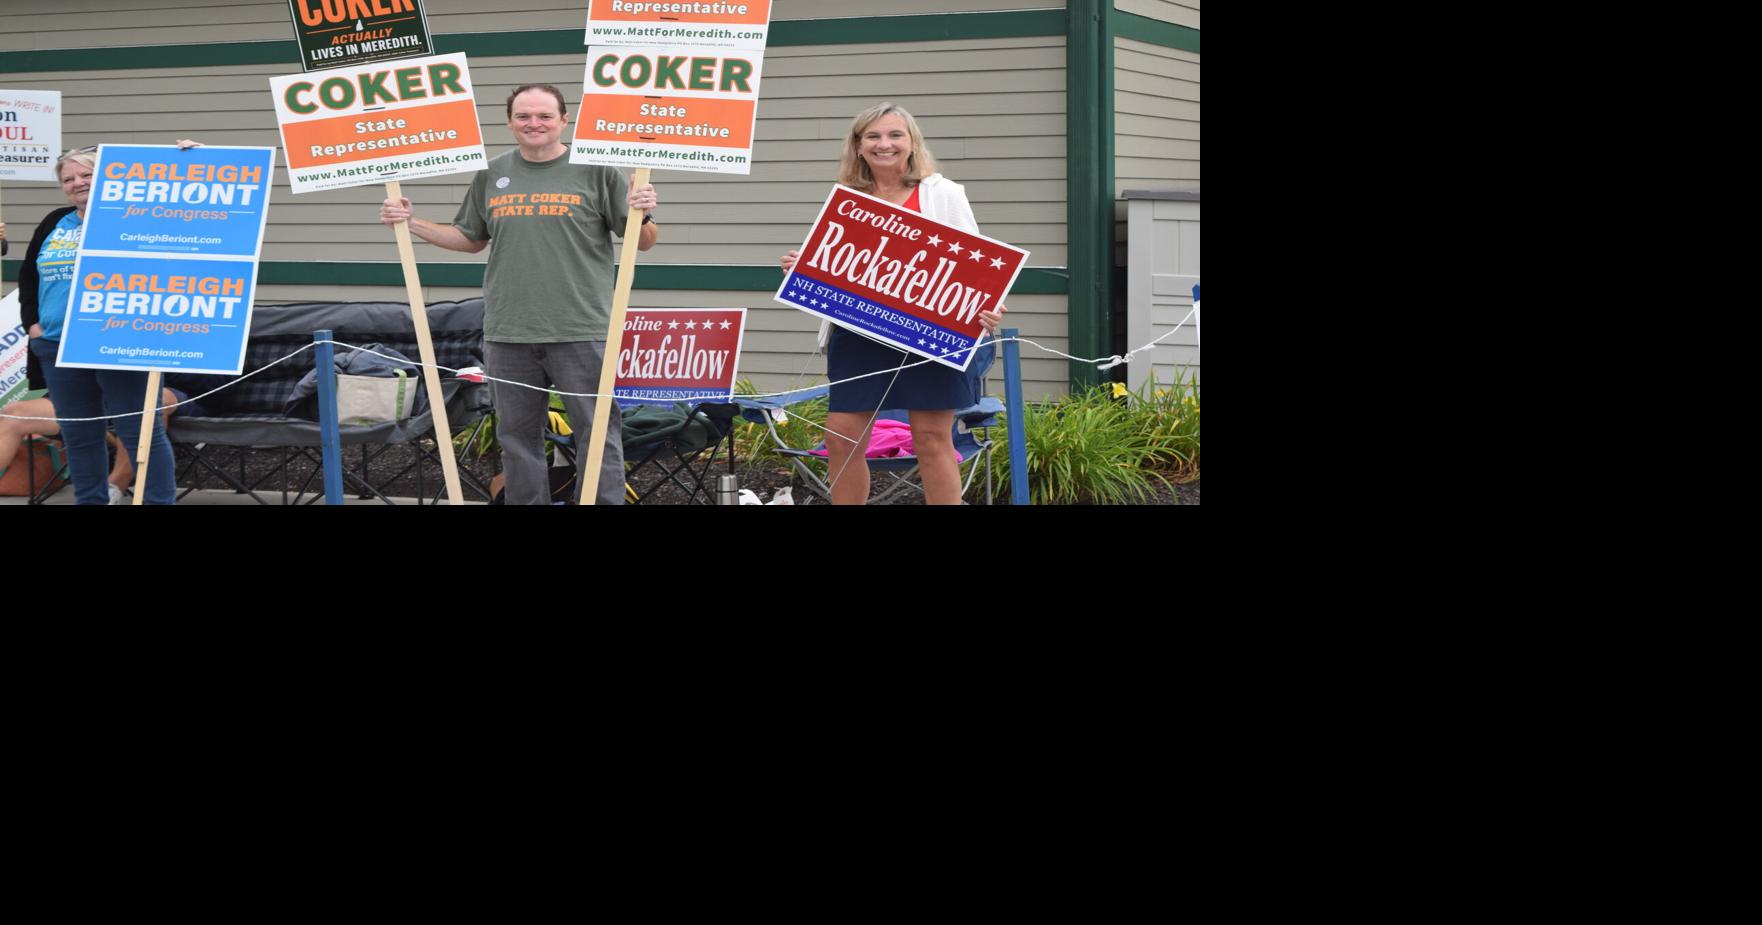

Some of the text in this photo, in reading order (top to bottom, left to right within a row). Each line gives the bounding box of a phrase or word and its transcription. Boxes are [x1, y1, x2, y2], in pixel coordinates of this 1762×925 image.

[612, 0, 748, 14] Representative
[331, 28, 393, 45] ACTUALLY
[592, 26, 763, 40] www.MattForMeredith.com
[311, 46, 344, 60] LIVES
[346, 43, 359, 55] IN
[361, 34, 422, 53] MEREDITH.
[592, 54, 754, 93] COKER
[284, 62, 467, 115] COKER
[640, 103, 687, 118] State
[355, 117, 407, 134] State
[595, 119, 730, 139] Representative
[311, 129, 458, 158] Representative
[576, 145, 747, 164] www.MattForMeredith.com
[104, 162, 262, 183] CARLEIGH
[297, 151, 483, 183] www.MattForMeredith.com
[100, 181, 259, 206] BERIONT
[488, 193, 581, 207] MATT COKER
[123, 205, 228, 221] for Congress
[493, 205, 574, 218] STATE REP.
[837, 199, 922, 241] Caroline
[119, 233, 222, 245] CarleighBeriont.com
[807, 220, 991, 325] Rockafellow
[83, 272, 245, 297] CARLEIGH
[79, 291, 242, 319] BERIONT
[793, 277, 969, 349] NH STATE REPRESENTATIVE
[102, 316, 209, 335] for Congress
[624, 316, 663, 332] oline
[100, 345, 204, 359] CarleighBeriont.com
[616, 334, 730, 380] ckafellow
